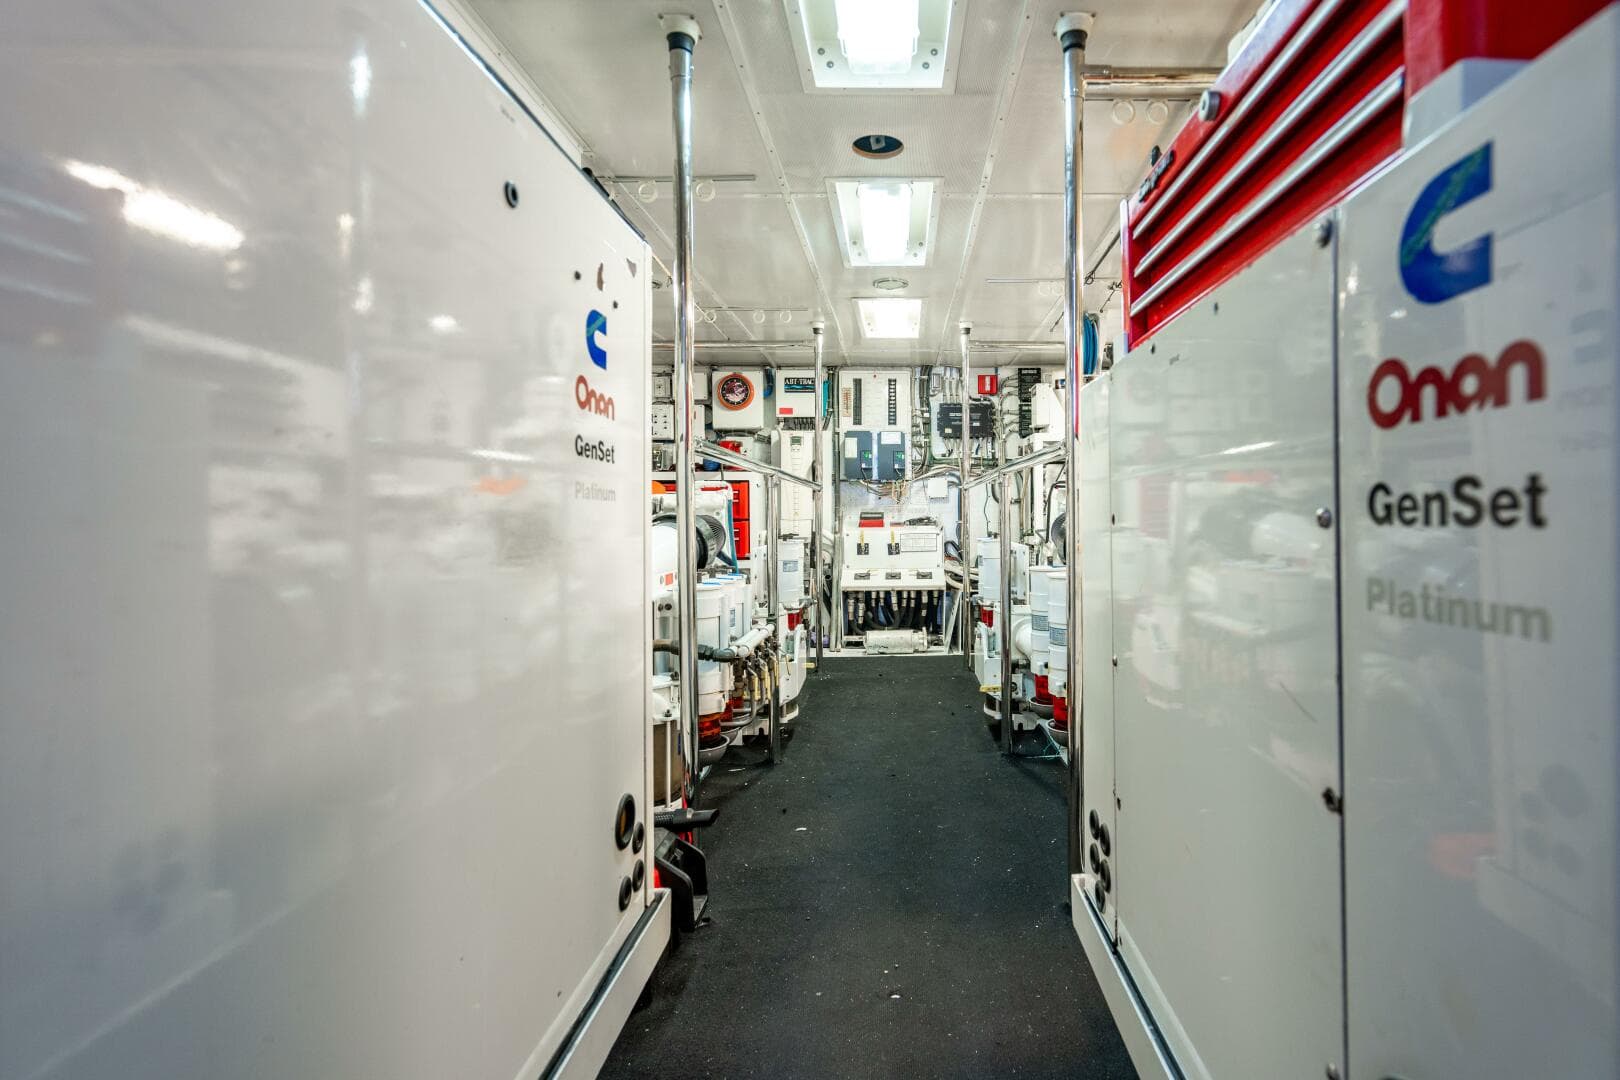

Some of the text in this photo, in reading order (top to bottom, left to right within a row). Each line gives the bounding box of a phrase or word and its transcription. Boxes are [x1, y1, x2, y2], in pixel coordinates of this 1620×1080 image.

[575, 374, 615, 421] Onan
[1367, 338, 1548, 430] Onan
[575, 434, 615, 465] GenSet
[574, 481, 617, 502] Platinum
[1367, 472, 1548, 529] GenSet
[1366, 577, 1554, 644] Platinum
